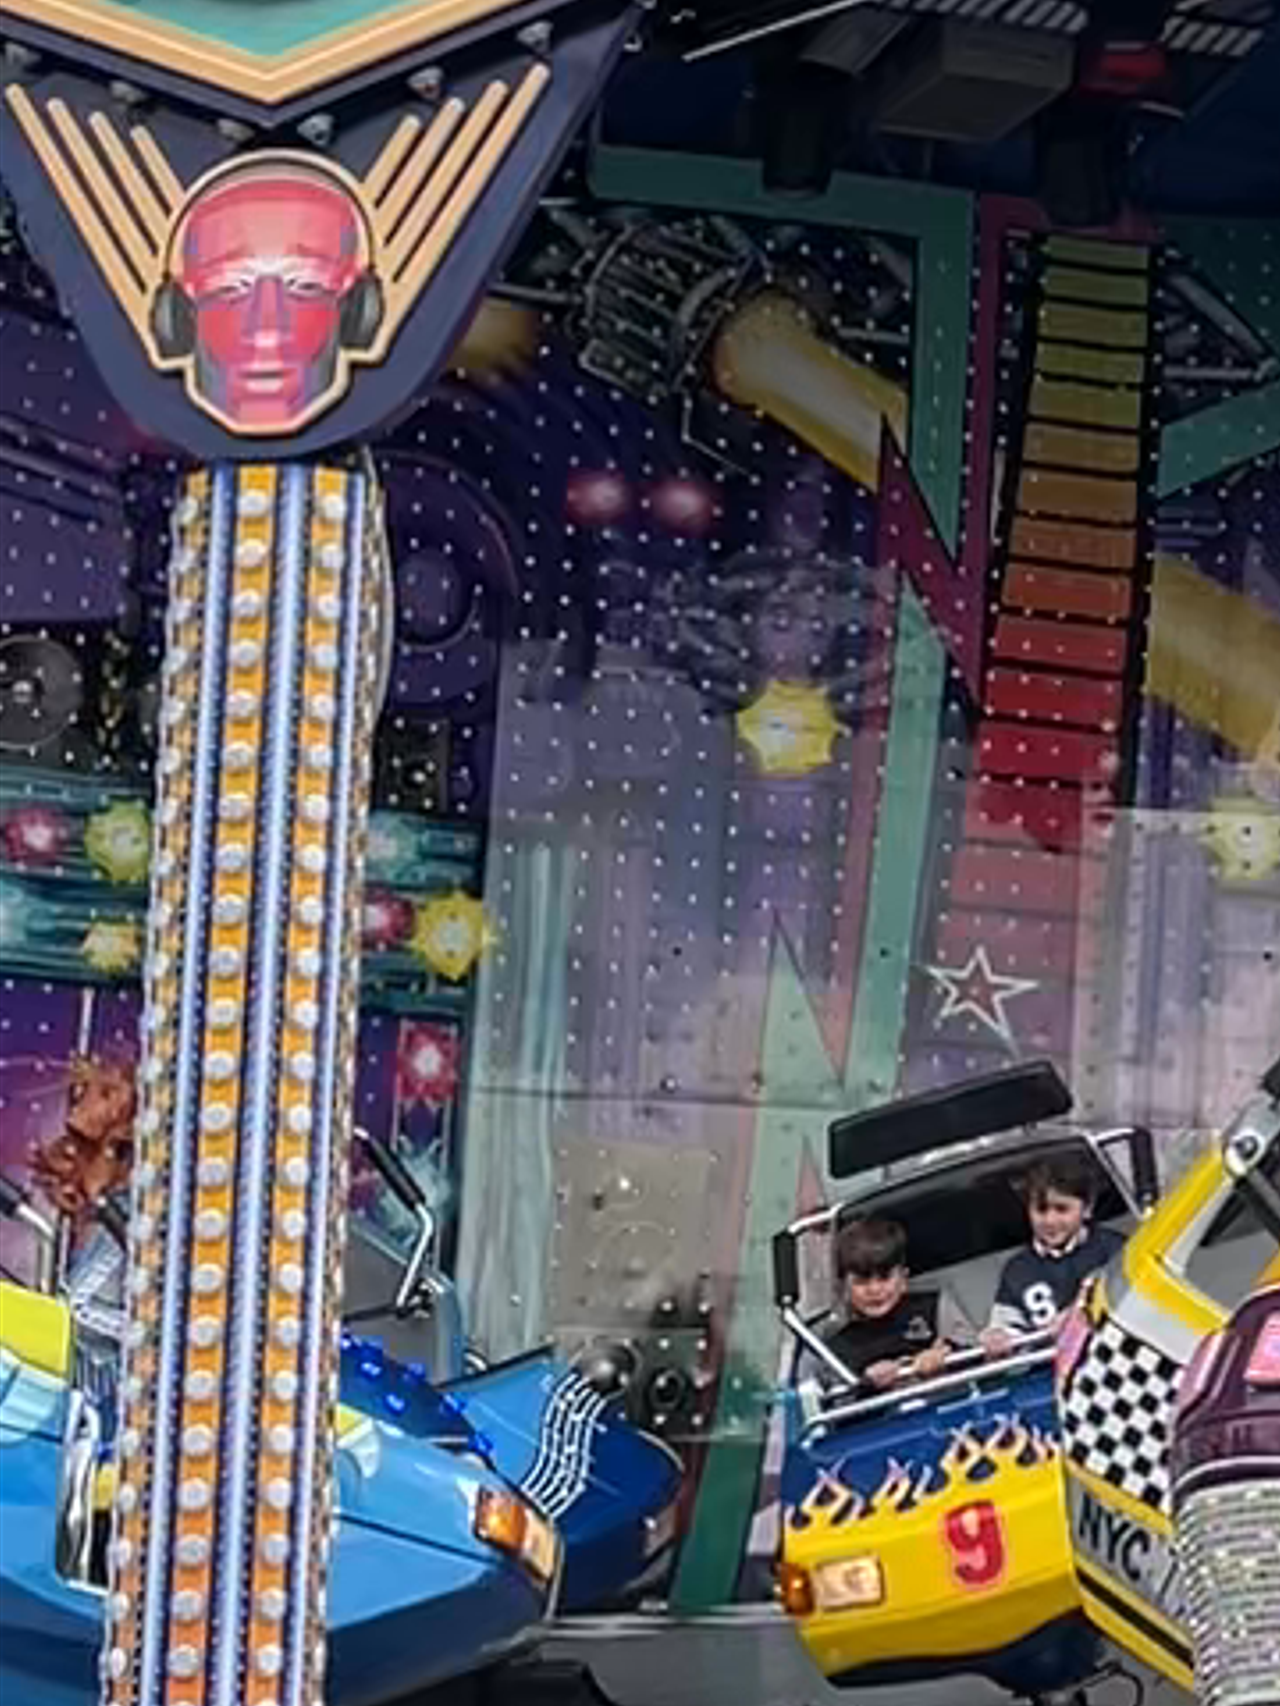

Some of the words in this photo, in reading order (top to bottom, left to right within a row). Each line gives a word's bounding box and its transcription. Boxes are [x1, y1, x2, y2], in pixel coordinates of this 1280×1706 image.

[1023, 1281, 1056, 1325] S
[944, 1500, 1008, 1589] 9
[1078, 1490, 1151, 1581] NYC
